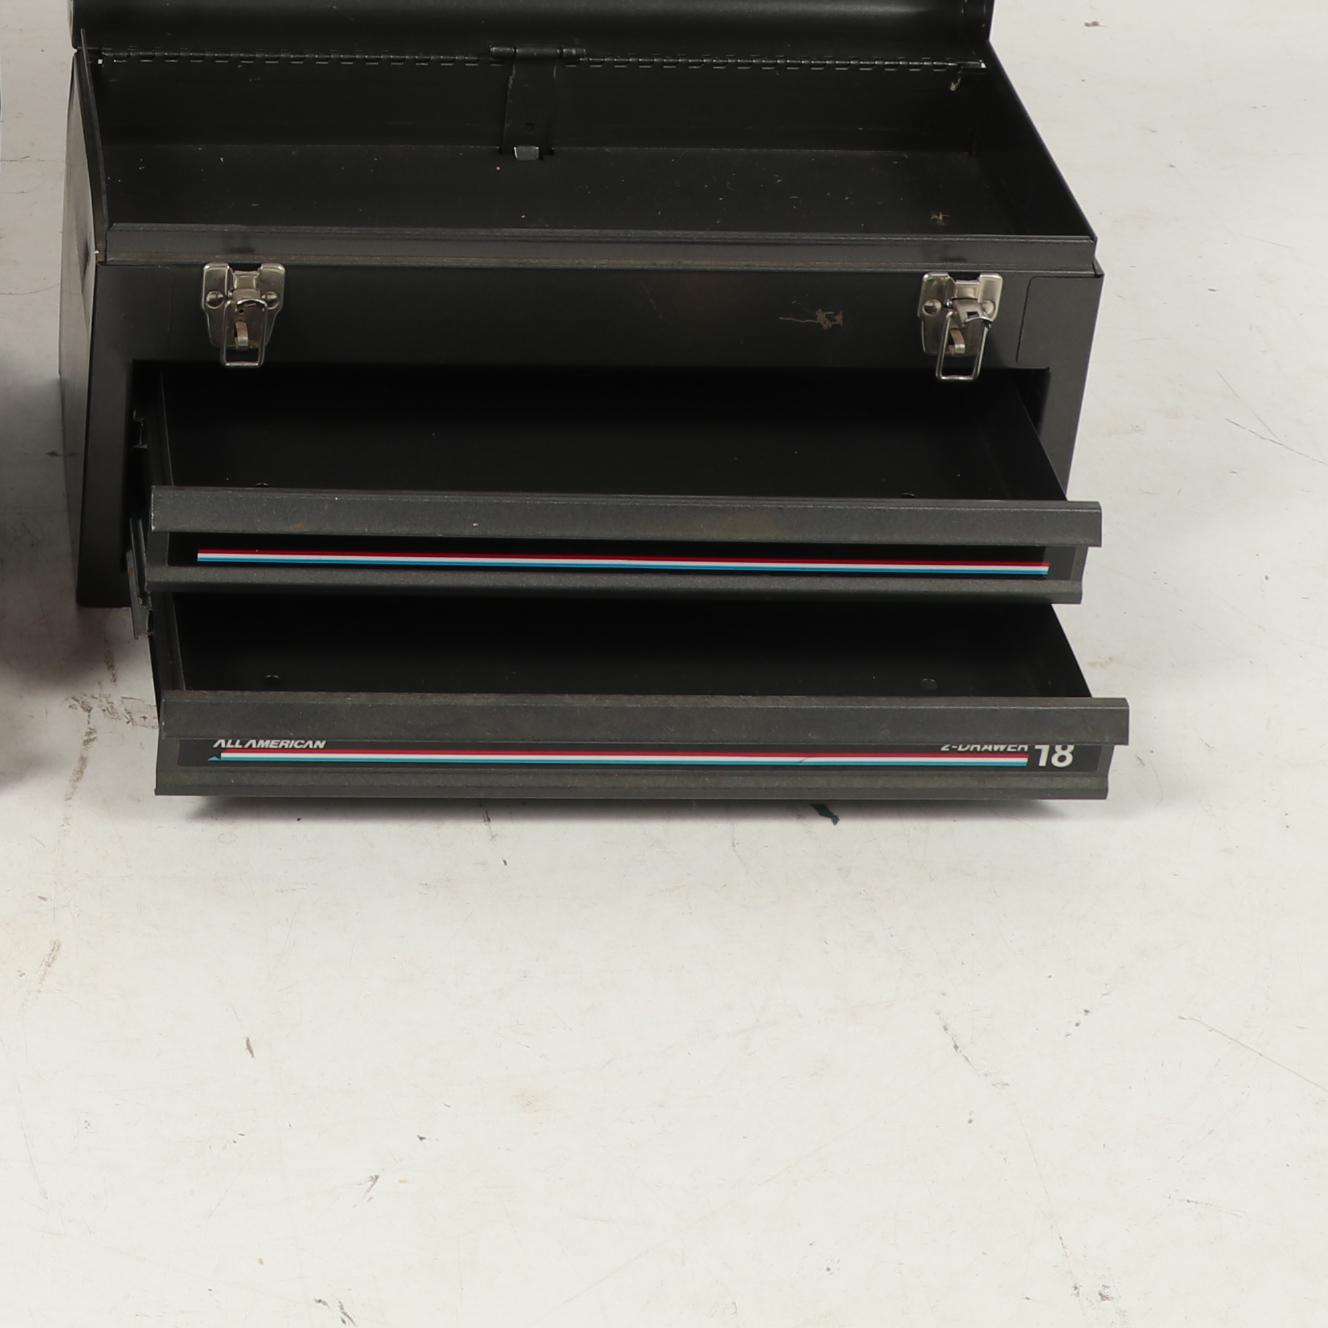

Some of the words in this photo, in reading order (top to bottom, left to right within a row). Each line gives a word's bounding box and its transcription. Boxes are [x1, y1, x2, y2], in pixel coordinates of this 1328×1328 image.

[213, 739, 243, 749] ALL
[244, 739, 327, 749] AMERICAN
[1034, 744, 1075, 768] 18
